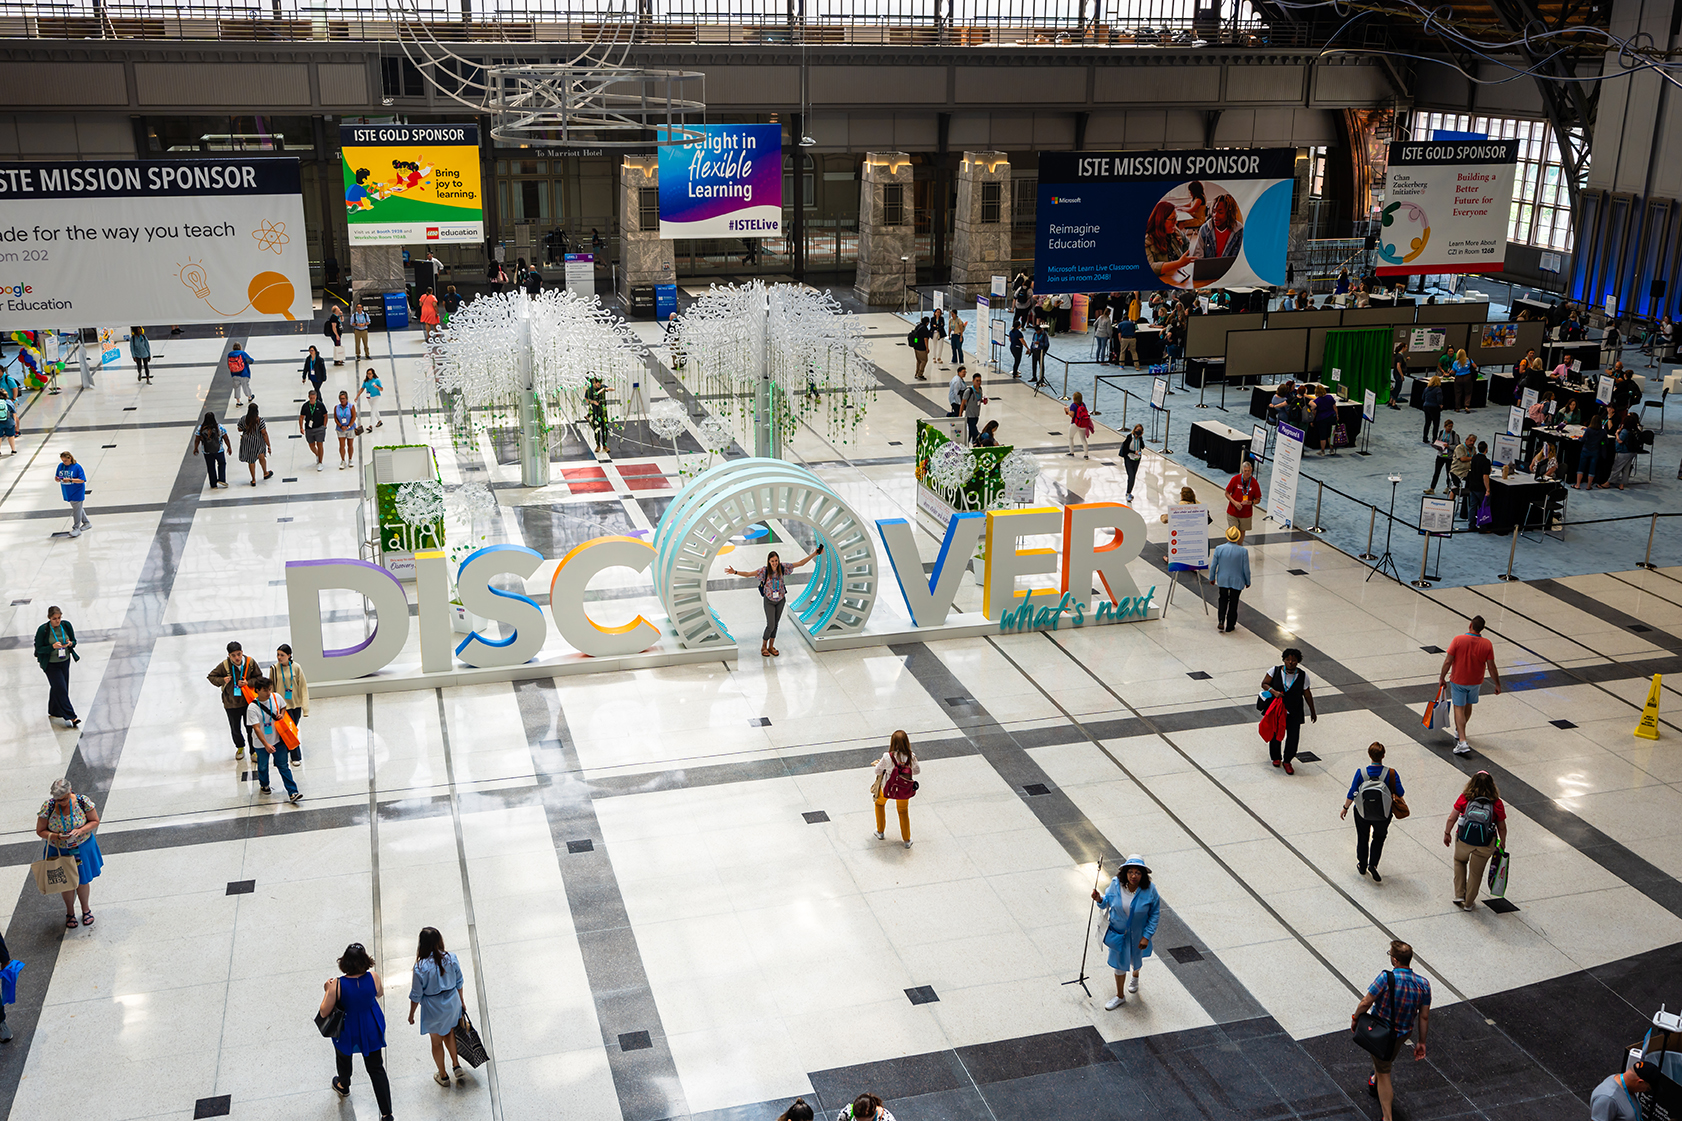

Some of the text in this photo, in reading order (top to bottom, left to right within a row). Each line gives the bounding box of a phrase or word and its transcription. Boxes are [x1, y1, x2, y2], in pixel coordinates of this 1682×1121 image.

[354, 128, 465, 142] ISTE GOLD SPONSOR
[683, 132, 756, 154] Delight in
[1402, 146, 1506, 160] ISTE GOLD SPONSOR
[688, 150, 752, 181] flexible
[1078, 156, 1260, 177] ISTE MISSION SPONSOR
[39, 167, 142, 192] MISSION
[148, 165, 258, 190] SPONSOR
[436, 168, 460, 178] Bring
[1457, 173, 1490, 182] Building
[436, 180, 450, 190] joy
[1456, 185, 1479, 193] Better
[436, 190, 477, 200] learning.
[688, 181, 752, 202] Learning
[1454, 196, 1494, 204] Future for
[1452, 208, 1488, 218] Everyone
[728, 219, 778, 231] #ISTELive
[1049, 224, 1100, 236] Reimagine
[32, 225, 60, 242] for
[66, 224, 98, 240] the
[101, 226, 140, 243] way
[144, 224, 179, 243] you
[184, 221, 236, 238] teach
[1048, 238, 1096, 250] Education
[22, 250, 49, 262] 202
[7, 298, 72, 311] Education
[1000, 585, 1156, 631] what's next
